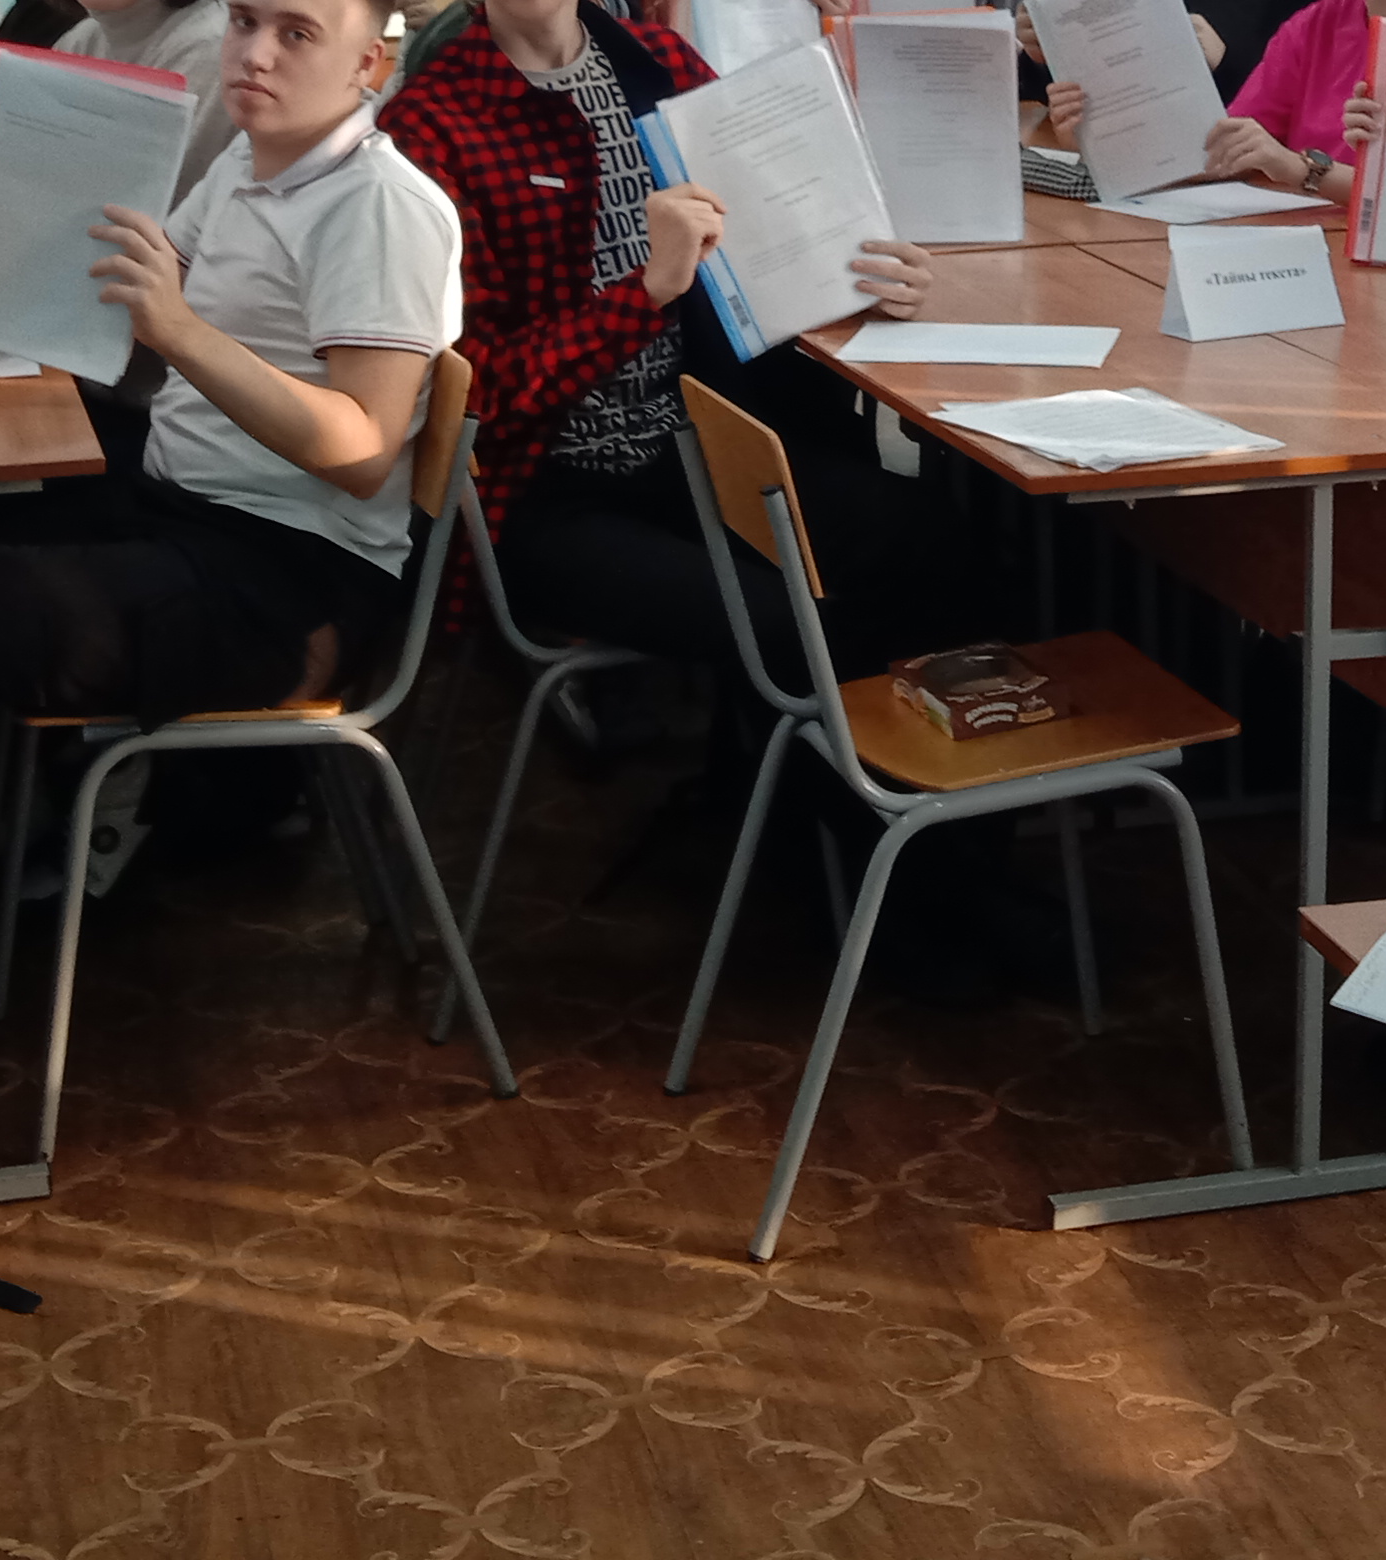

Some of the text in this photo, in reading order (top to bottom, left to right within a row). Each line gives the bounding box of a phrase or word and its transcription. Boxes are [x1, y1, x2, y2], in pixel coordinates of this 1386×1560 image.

[571, 83, 627, 113] UDE
[1205, 268, 1308, 286] «Тайны текста»
